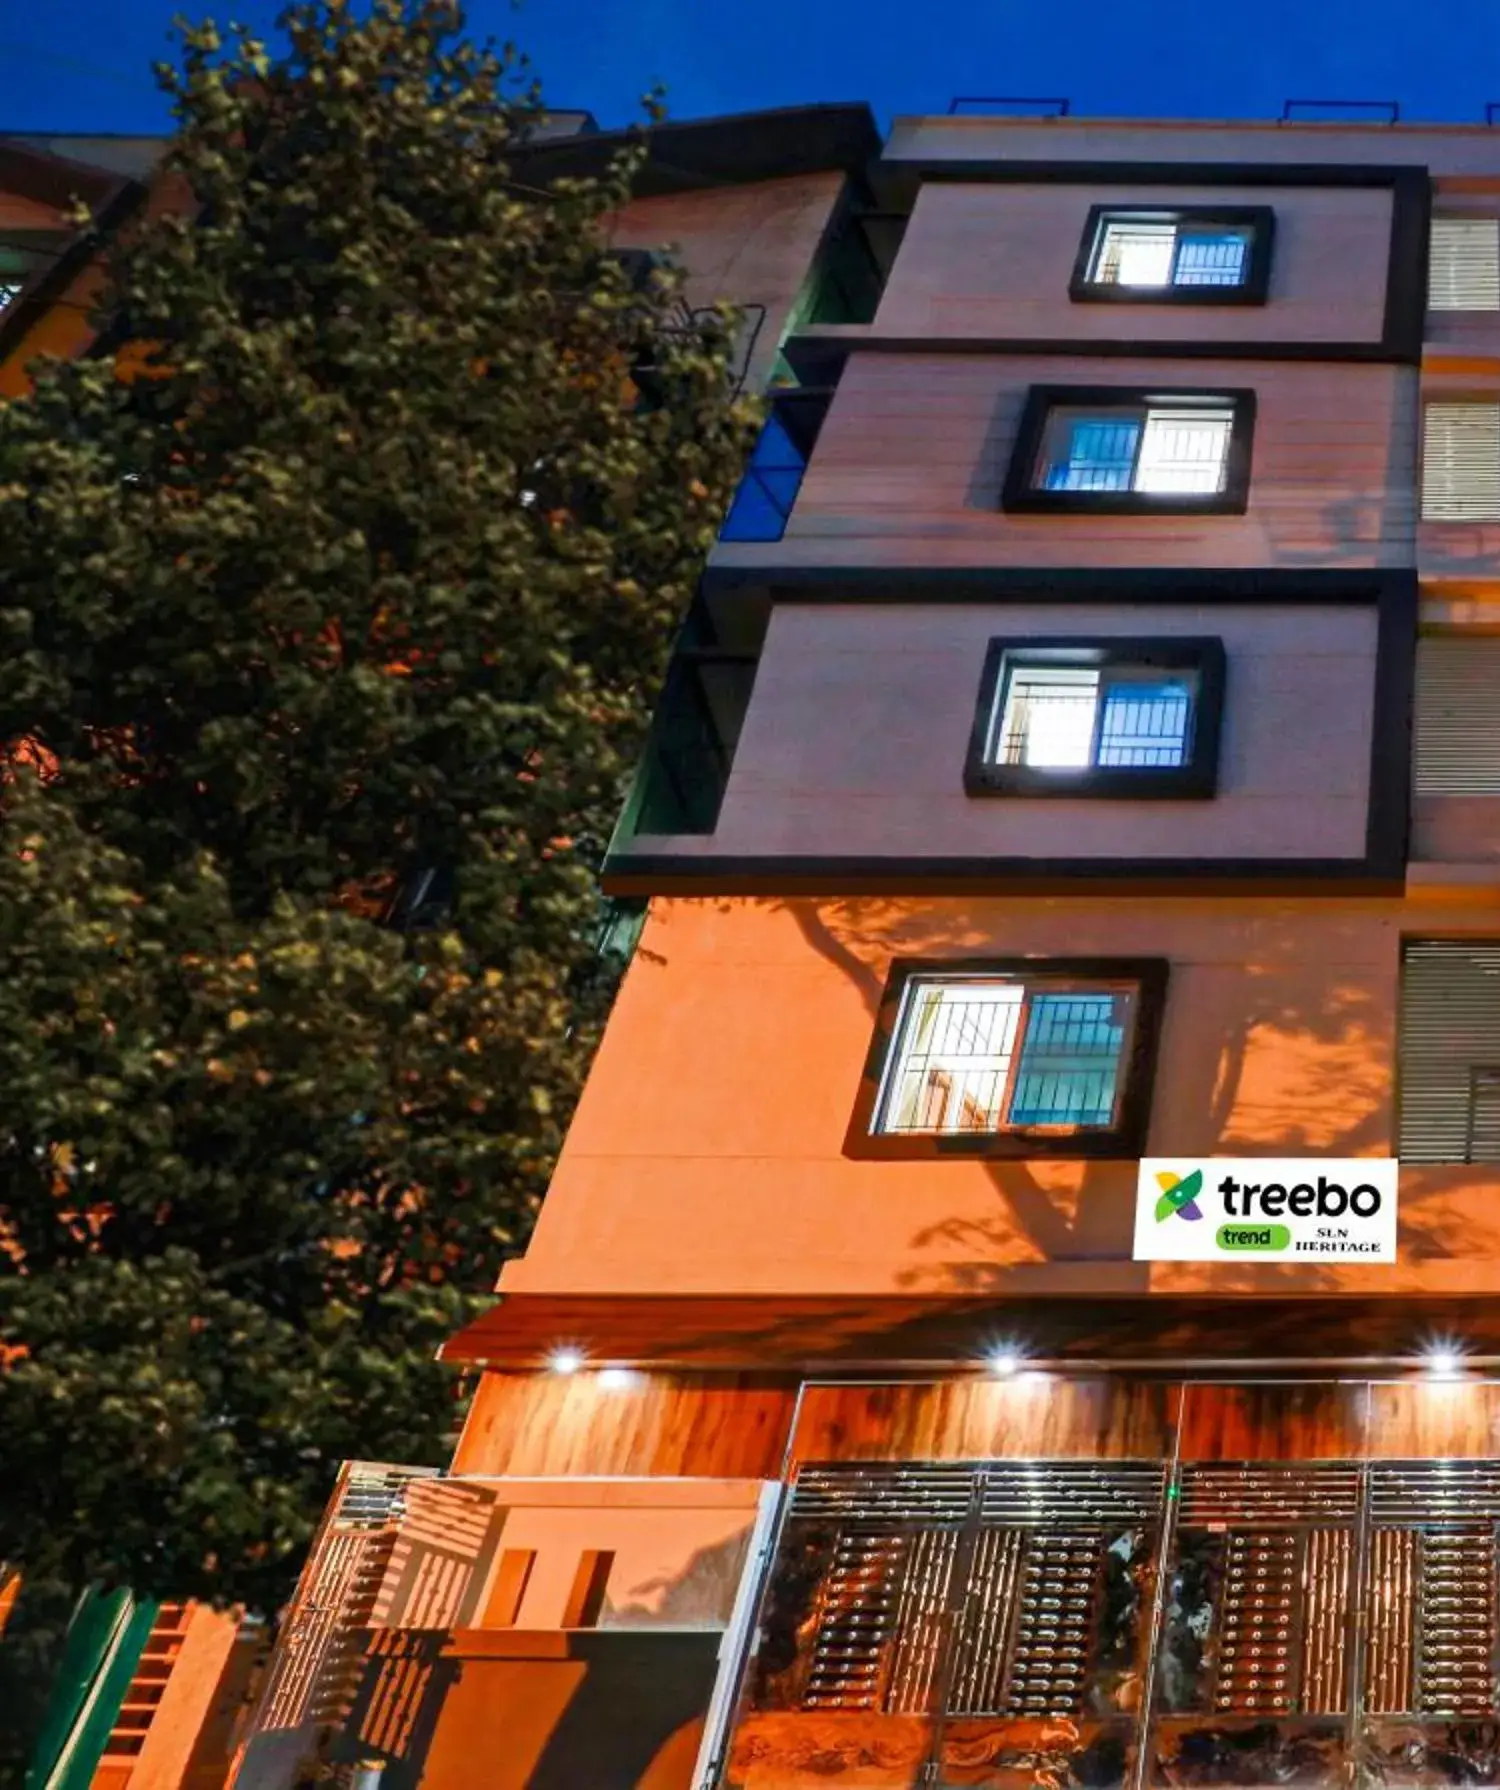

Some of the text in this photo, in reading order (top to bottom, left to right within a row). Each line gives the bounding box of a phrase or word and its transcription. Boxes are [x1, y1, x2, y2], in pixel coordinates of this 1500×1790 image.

[1217, 1176, 1382, 1218] treebo
[1223, 1228, 1271, 1245] trend
[1316, 1227, 1349, 1239] SLN
[1295, 1241, 1381, 1253] HERITAGE
